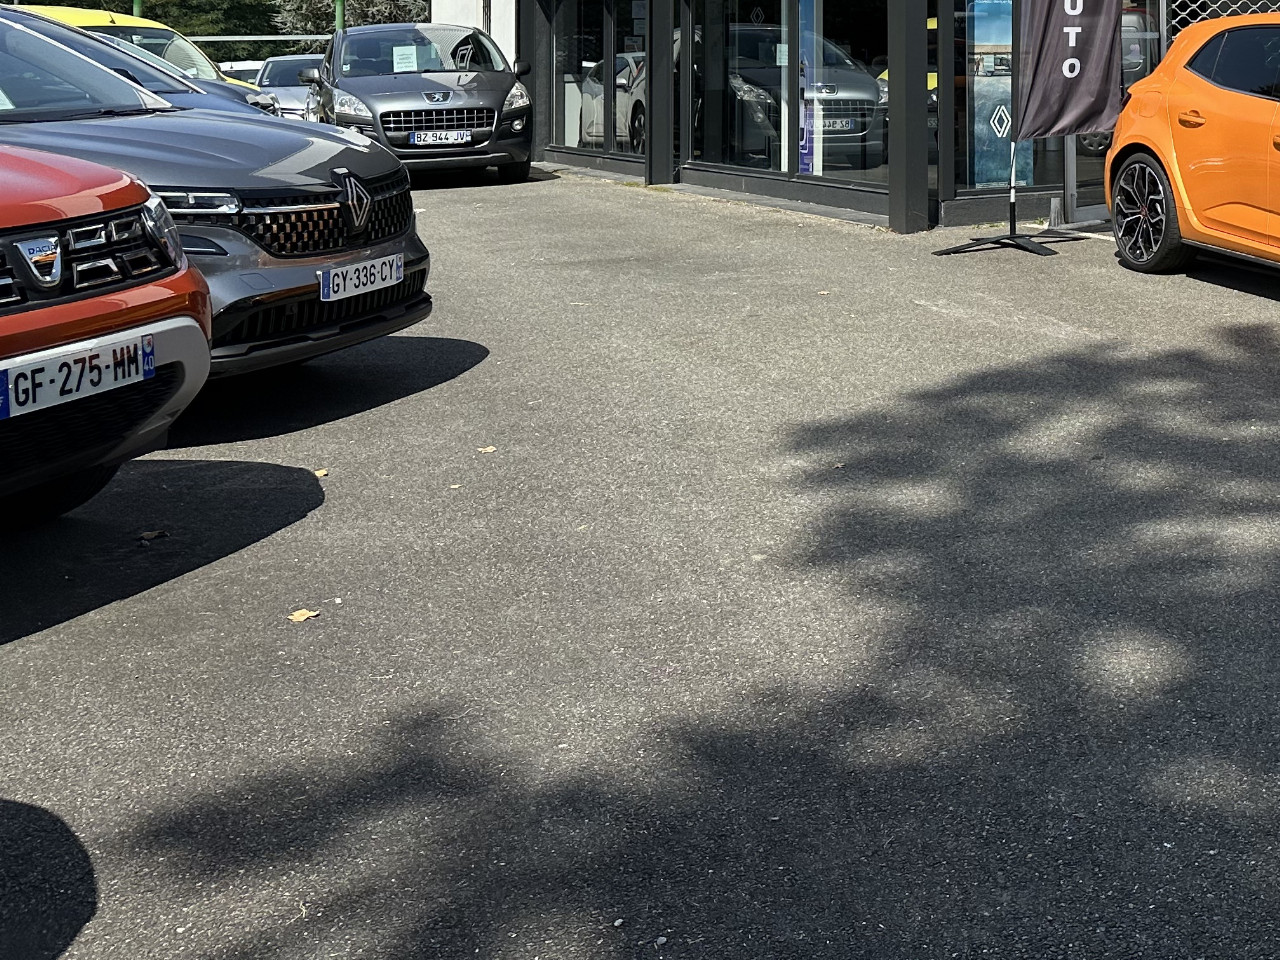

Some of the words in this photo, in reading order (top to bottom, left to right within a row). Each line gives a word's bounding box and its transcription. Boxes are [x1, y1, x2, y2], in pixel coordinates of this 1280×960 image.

[27, 245, 58, 255] DACIA
[332, 258, 395, 294] GY-336-CY
[143, 355, 154, 370] 40
[14, 344, 140, 407] GF-275-MM
